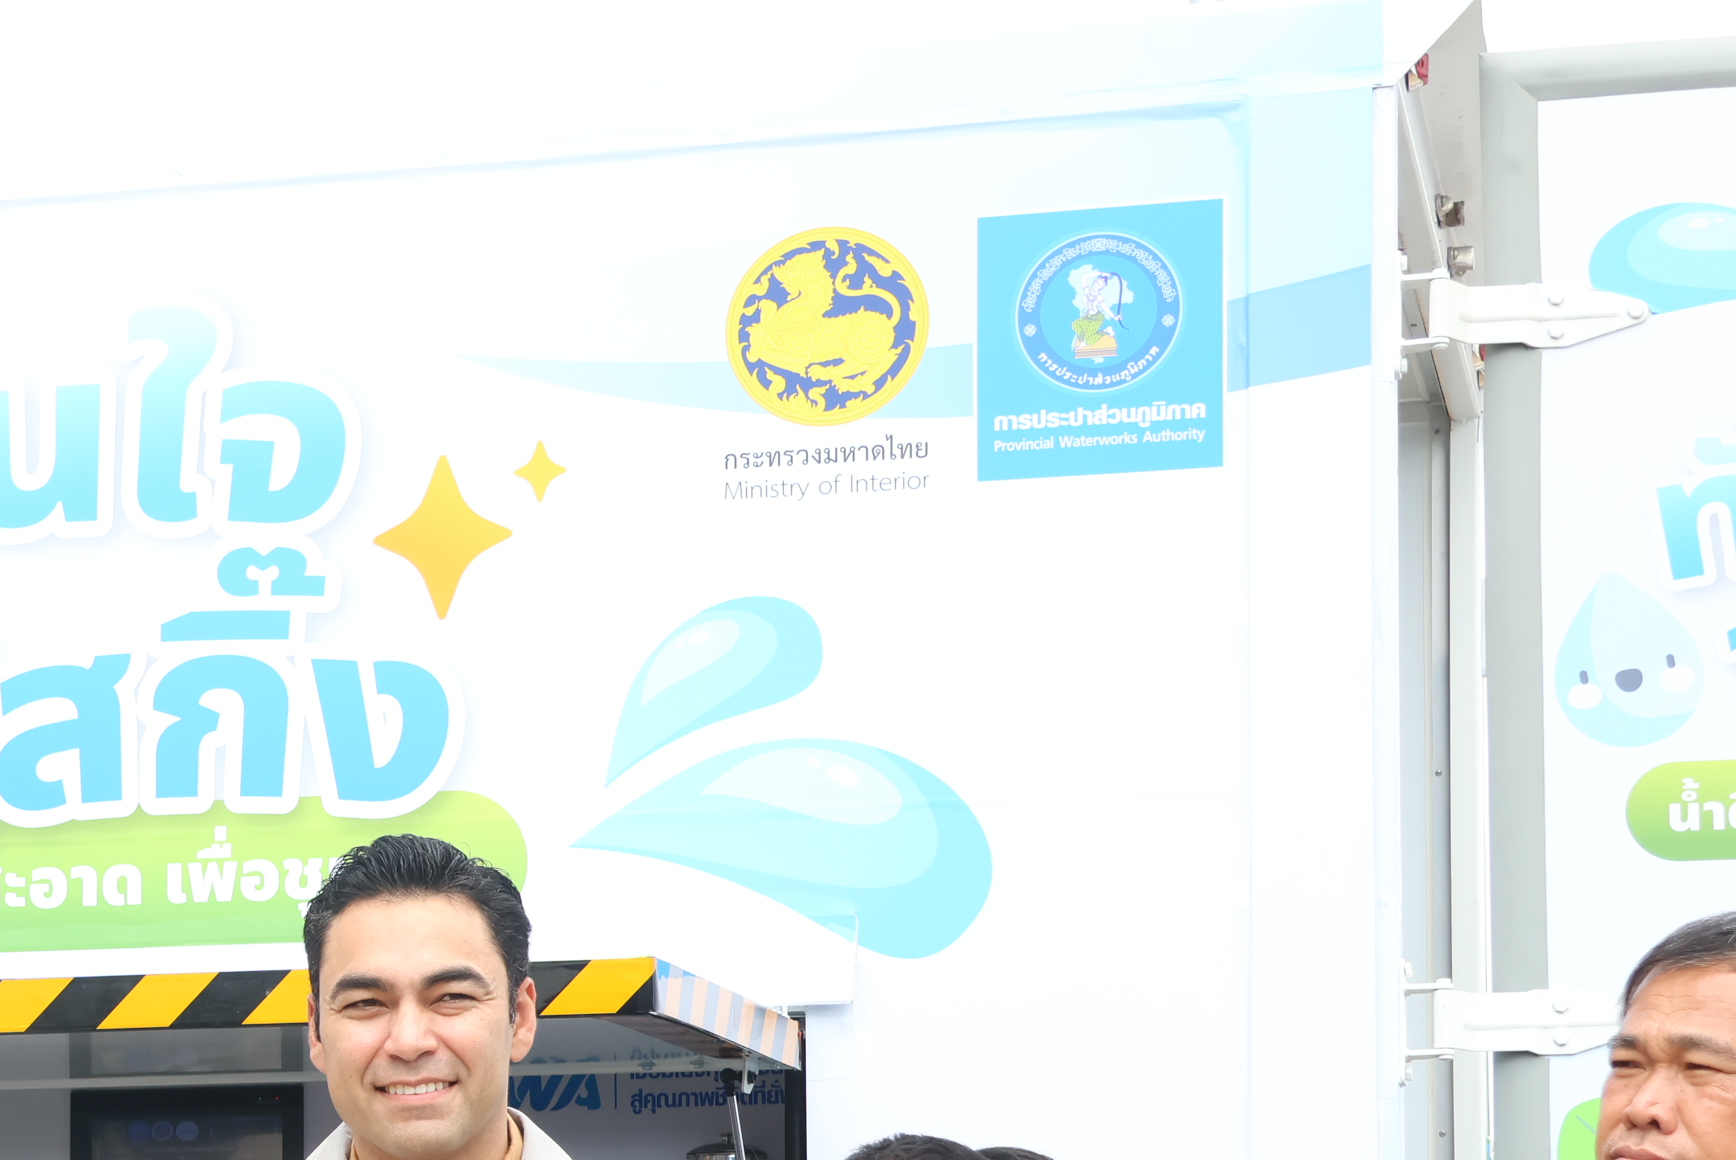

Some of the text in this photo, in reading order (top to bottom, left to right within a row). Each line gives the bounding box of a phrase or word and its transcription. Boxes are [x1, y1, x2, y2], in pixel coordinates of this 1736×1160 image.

[993, 401, 1207, 431] การประปาส่วนภูมิภาค
[724, 434, 929, 470] กระทรวงมหาดไทย
[993, 427, 1206, 452] Provincial Waterworks Authority
[724, 472, 930, 501] Ministry of Interior
